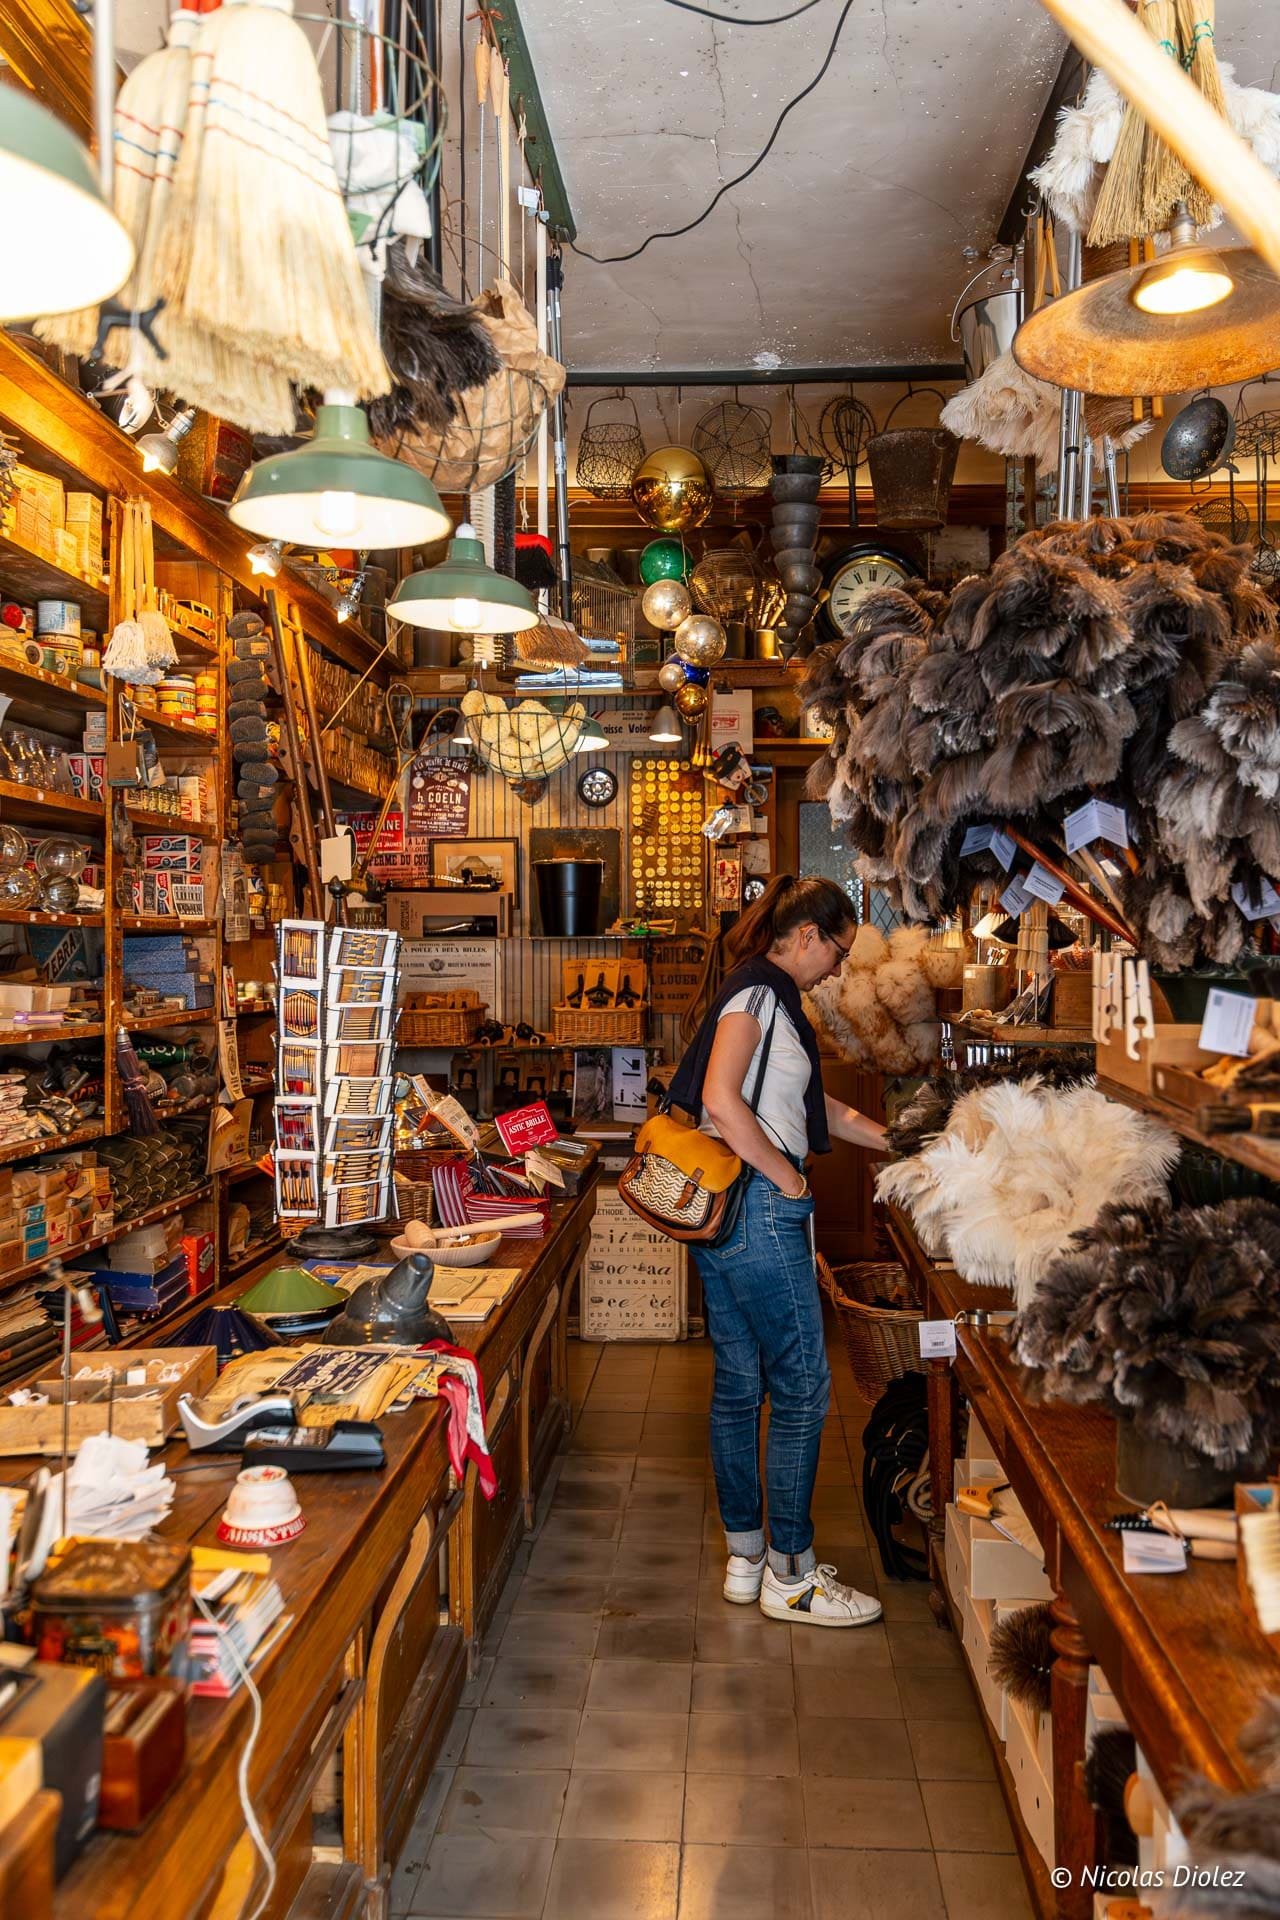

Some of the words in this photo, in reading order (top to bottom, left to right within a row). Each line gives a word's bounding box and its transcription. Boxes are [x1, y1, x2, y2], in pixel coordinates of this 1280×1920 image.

[603, 724, 623, 734] aisse
[428, 792, 462, 804] COELN
[352, 818, 401, 831] NÉGINE
[400, 854, 411, 866] DU
[660, 974, 698, 985] LOUER
[508, 1122, 526, 1135] ASTIC
[525, 1115, 545, 1129] BRILLE
